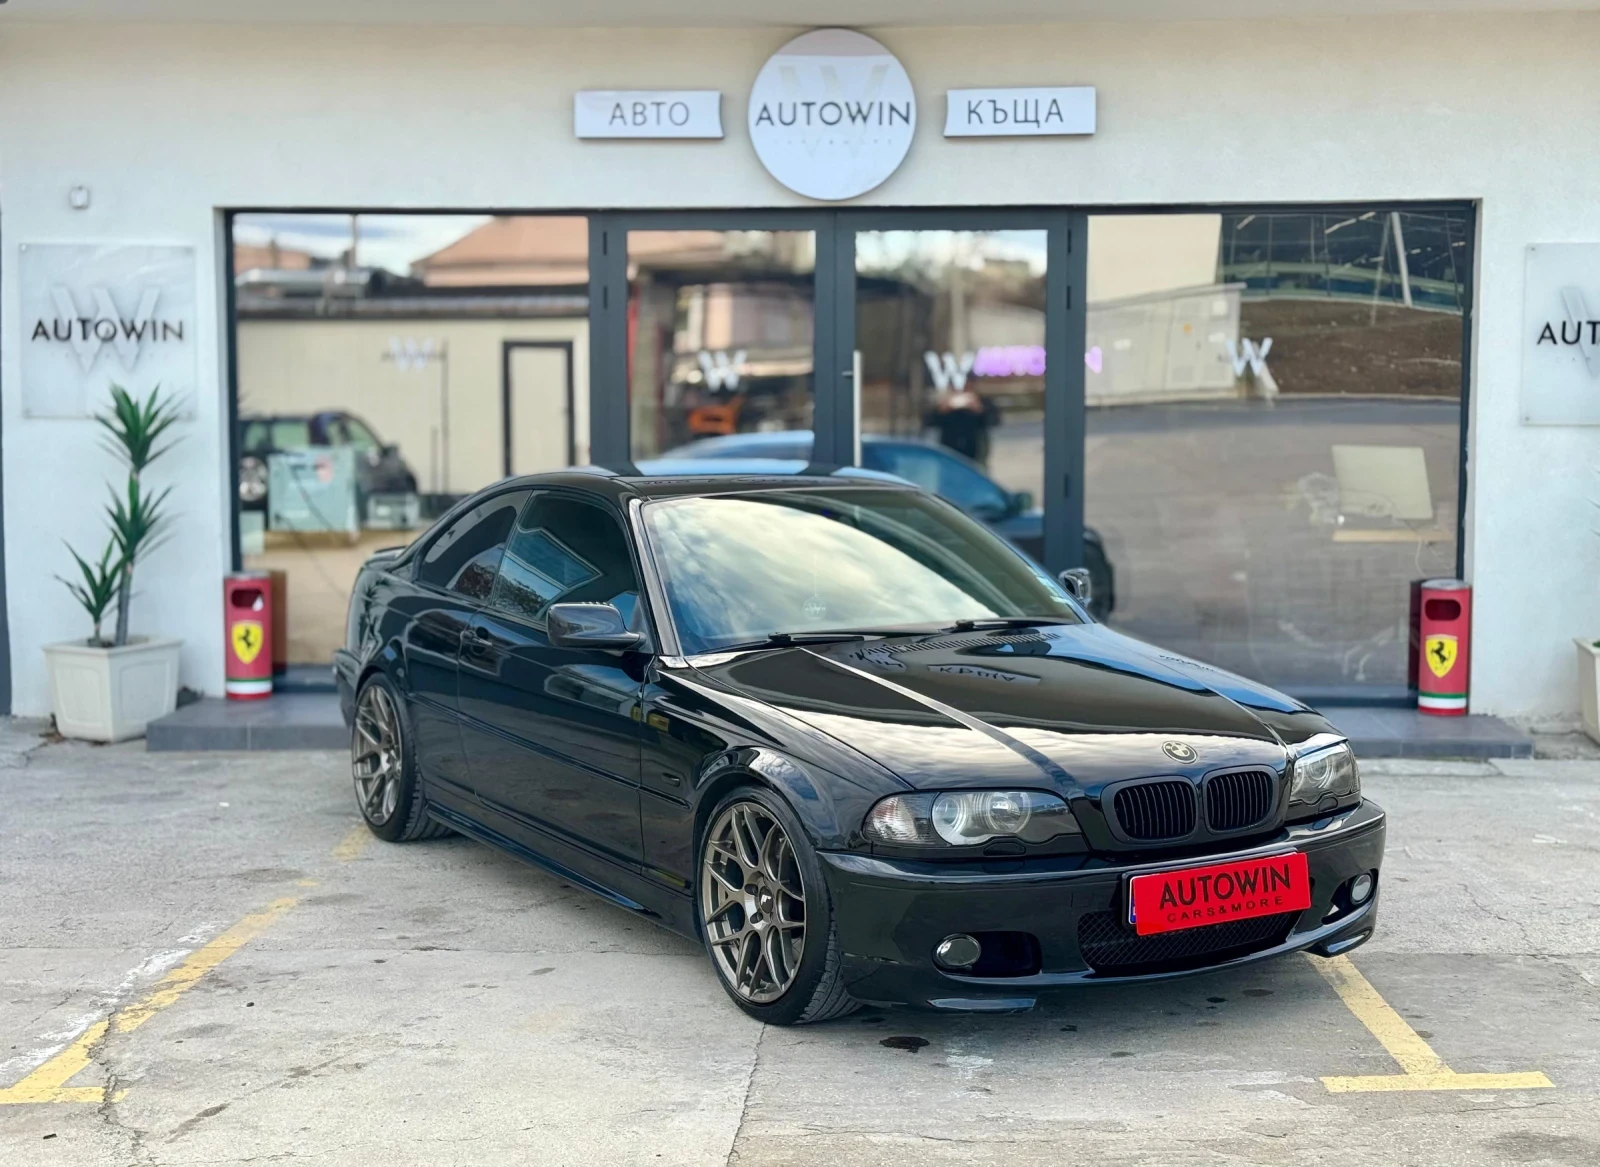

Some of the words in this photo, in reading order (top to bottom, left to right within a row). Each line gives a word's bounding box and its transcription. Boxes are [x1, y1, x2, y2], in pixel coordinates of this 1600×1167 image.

[608, 101, 690, 127] АВТО
[755, 101, 911, 127] AUTOWIN
[967, 98, 1064, 129] КЪЩА
[31, 317, 185, 343] AUTOWIN
[923, 350, 976, 391] W
[1225, 336, 1274, 378] W
[1159, 863, 1291, 910] AUTOWIN
[1167, 895, 1284, 924] CARS&MORE
